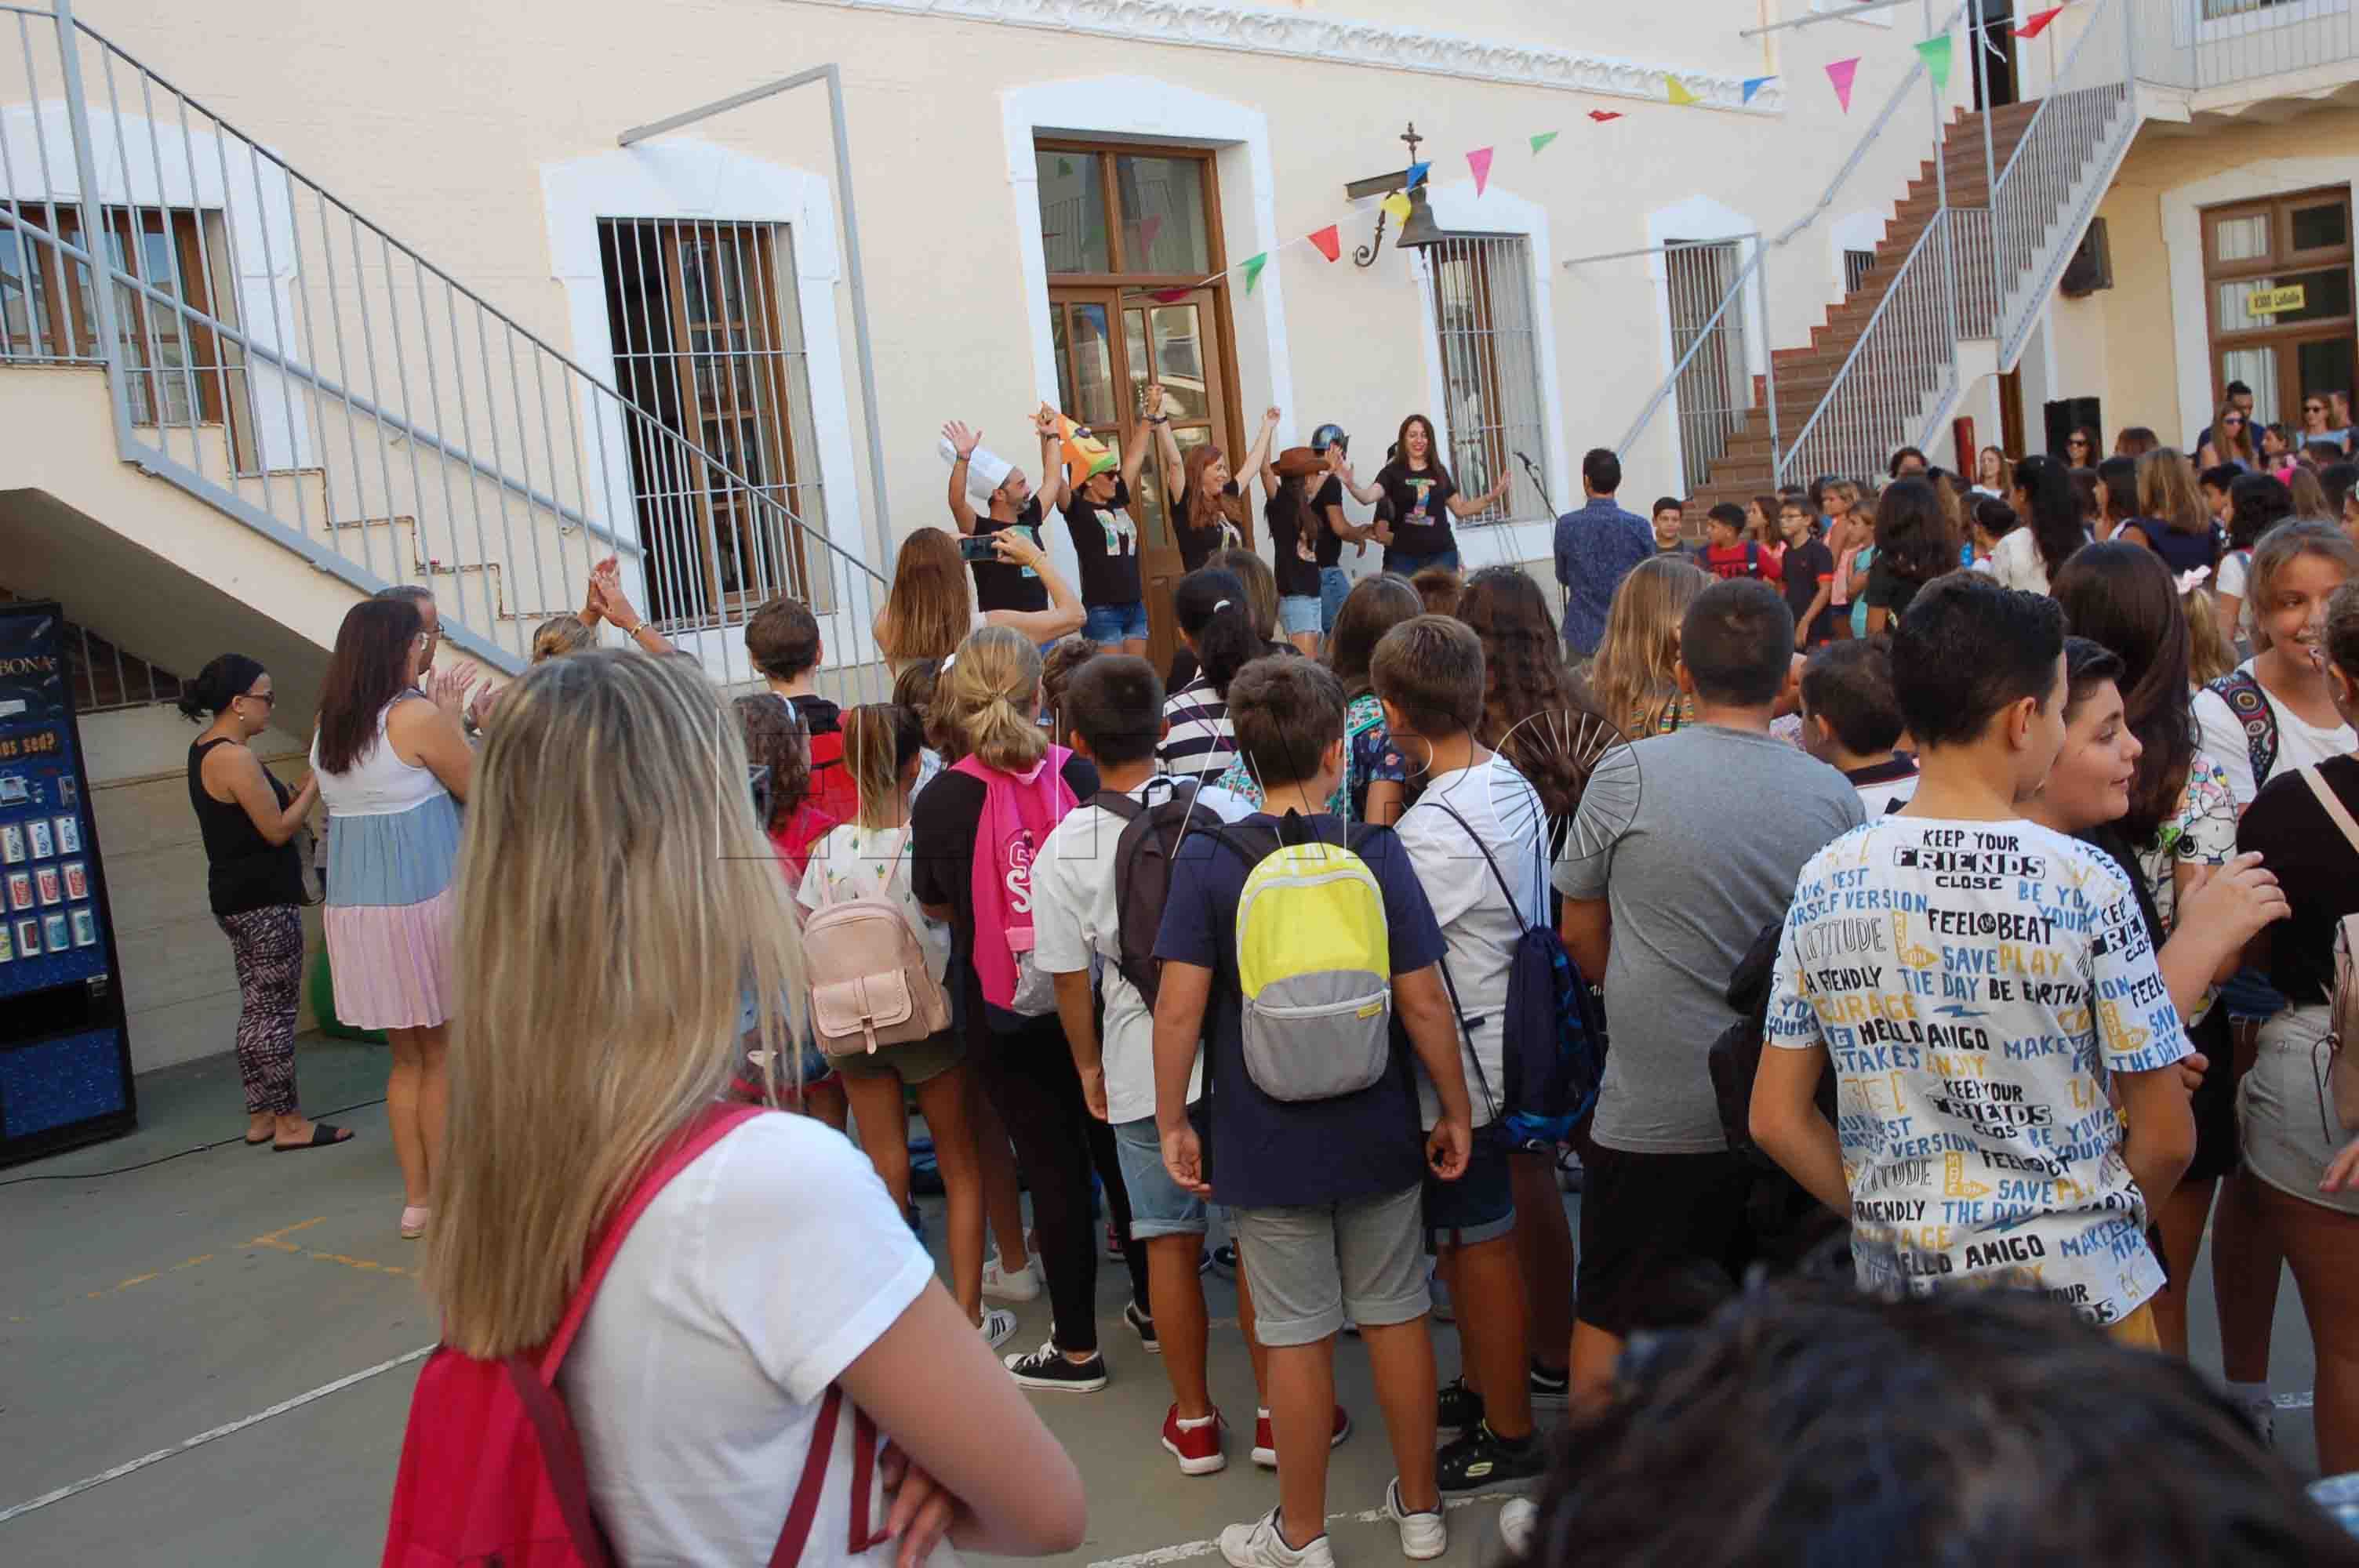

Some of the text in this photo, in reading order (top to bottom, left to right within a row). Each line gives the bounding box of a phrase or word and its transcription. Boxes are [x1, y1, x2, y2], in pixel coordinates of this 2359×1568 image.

[1923, 829, 2019, 852] KEEP YOUR
[1894, 847, 2046, 879] FRIENDS
[1936, 876, 2002, 890] CLOSE
[2019, 880, 2042, 902] BE
[1845, 889, 1928, 913] VERSION
[1928, 908, 1979, 936] FEEL
[1997, 912, 2057, 945] BEAT
[1943, 944, 1997, 975] SAVE
[2000, 944, 2065, 977] PLAY
[1943, 971, 1980, 1003] DAY
[1989, 977, 2015, 1003] BE
[1859, 1018, 1925, 1047] HELLO
[1998, 1179, 2053, 1205] SAVE
[1853, 1200, 1925, 1222] RIENDLY
[1941, 1201, 1984, 1224] THE
[1965, 1236, 2045, 1269] AMIGO
